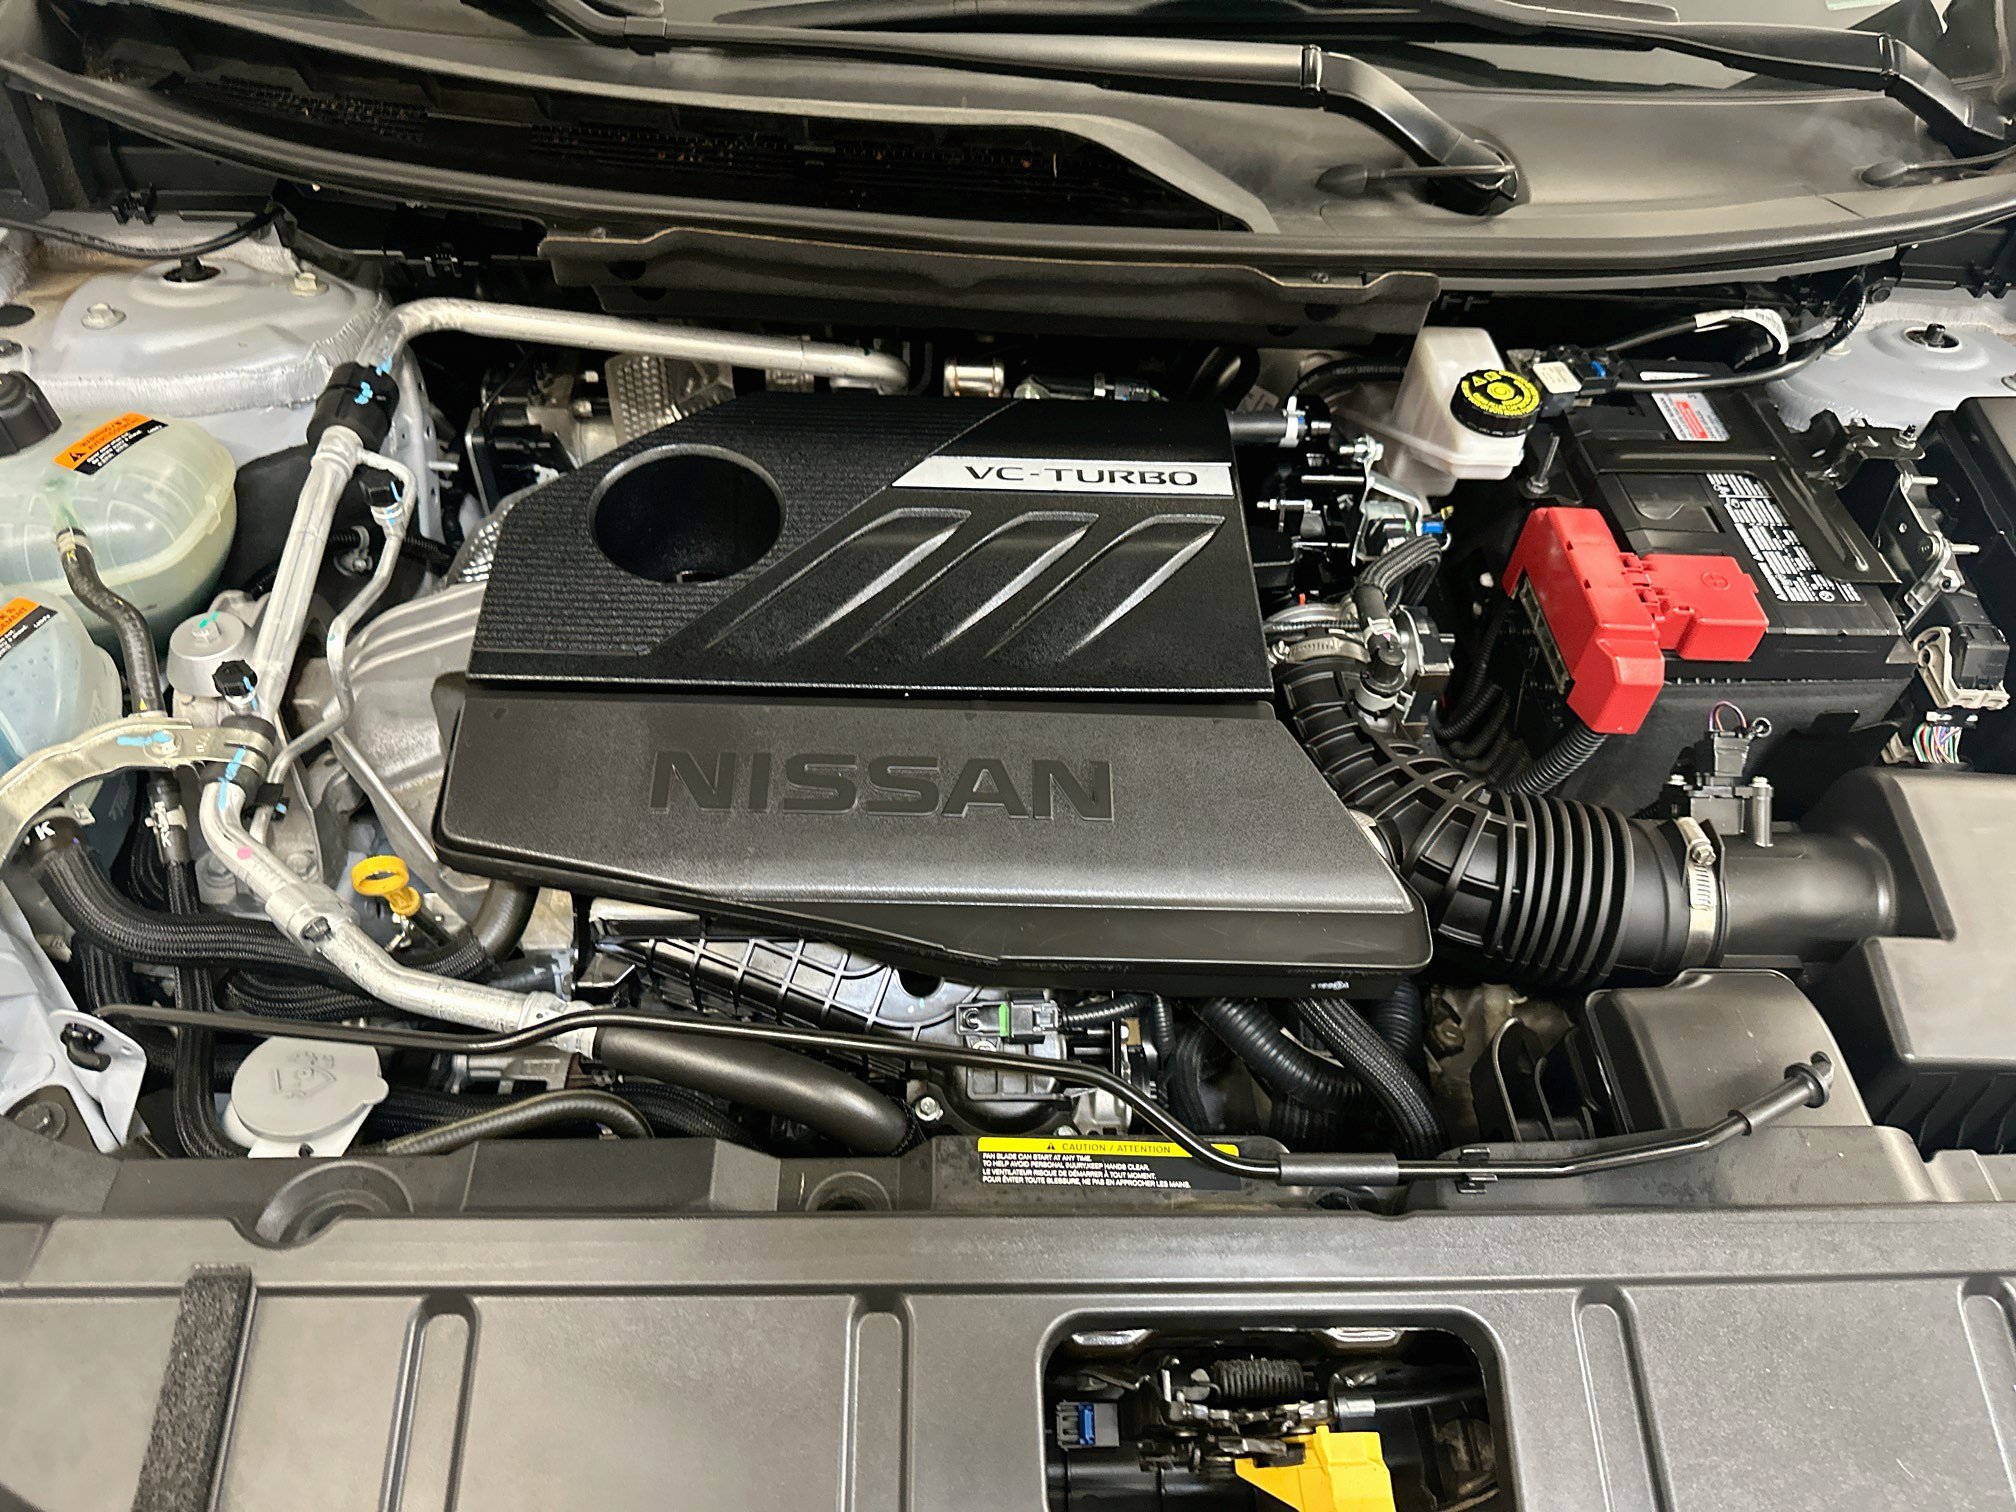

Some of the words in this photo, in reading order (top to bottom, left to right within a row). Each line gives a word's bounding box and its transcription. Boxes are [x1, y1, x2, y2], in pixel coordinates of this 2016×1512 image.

[965, 465, 1199, 486] VC-TURBO
[650, 751, 1115, 822] NISSAN
[1061, 1142, 1106, 1151] CAUTION
[1117, 1144, 1171, 1153] ATTENTION
[982, 1152, 996, 1160] FAN
[1032, 1153, 1053, 1161] START
[1053, 1154, 1061, 1162] AT
[1062, 1154, 1075, 1162] ANY
[983, 1159, 992, 1167] TO
[992, 1160, 1010, 1168] HELP
[1010, 1160, 1030, 1168] AVOID
[1030, 1160, 1065, 1168] PERSONAL
[1103, 1162, 1126, 1170] HANDS
[991, 1168, 1033, 1176] VENTILATEUR
[1033, 1169, 1057, 1177] RISQUE
[1058, 1169, 1068, 1177] DE
[1068, 1168, 1103, 1178] DÉMARRER
[1110, 1171, 1126, 1179] TOUT
[982, 1175, 1001, 1183] POUR
[1024, 1176, 1046, 1184] TOUTE
[1082, 1178, 1091, 1186] NE
[1092, 1178, 1105, 1186] PAS
[1105, 1178, 1115, 1187] EN
[1116, 1179, 1156, 1188] APPROCHER
[1156, 1180, 1168, 1188] LES
